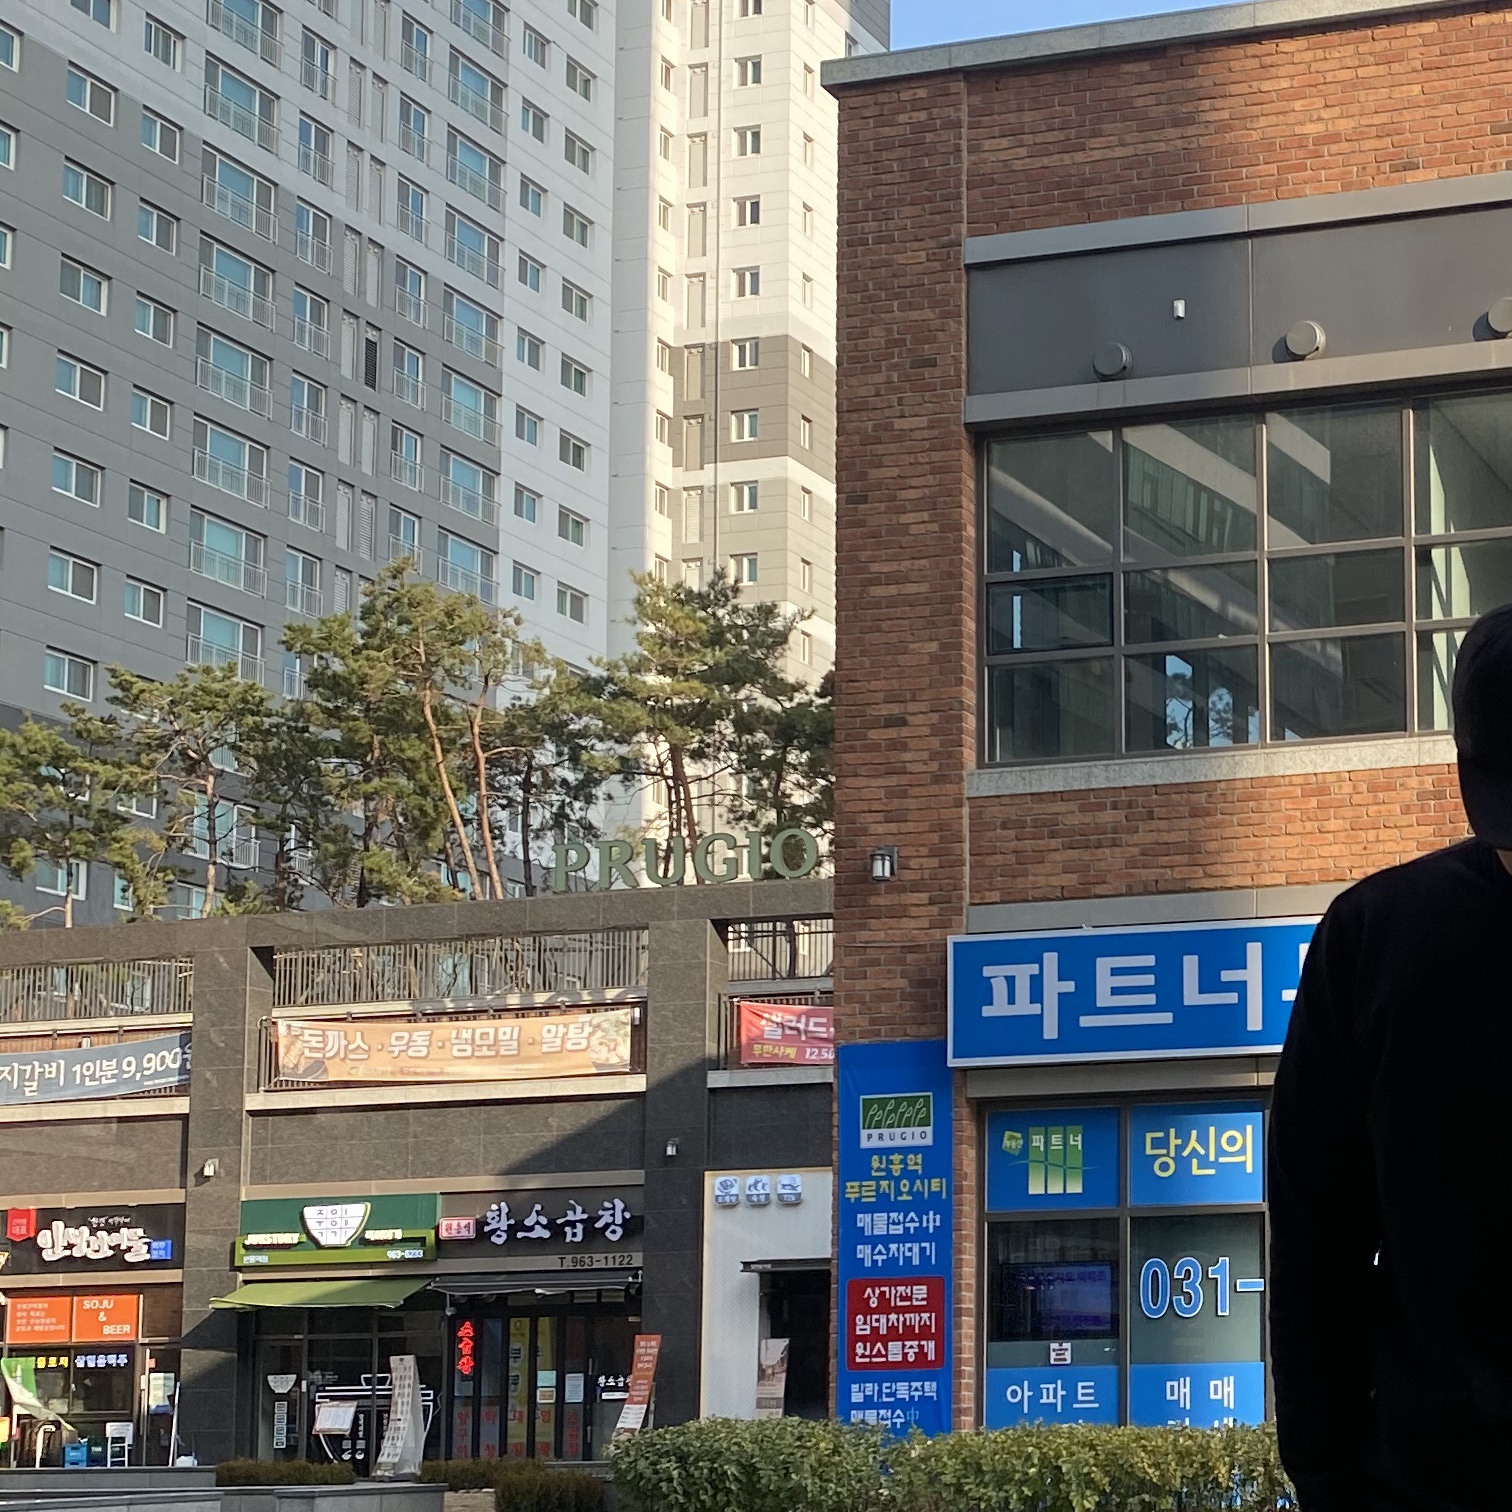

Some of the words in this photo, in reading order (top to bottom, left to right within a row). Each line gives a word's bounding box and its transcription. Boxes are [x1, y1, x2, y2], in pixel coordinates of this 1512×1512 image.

[551, 828, 819, 893] PRUGIO
[981, 940, 1312, 1041] 파트너
[301, 1029, 370, 1060] 돈까스
[387, 1029, 433, 1058] 우동
[450, 1024, 521, 1057] 냉모밀
[72, 1058, 119, 1086] 1인분
[866, 1130, 928, 1142] PRUGIO
[1031, 1132, 1083, 1152] 파트너
[1145, 1124, 1253, 1178] 당신의
[871, 1153, 923, 1177] 원흥역
[845, 1177, 947, 1204] 푸르지오시티
[483, 1198, 632, 1245] 황소곱창
[558, 1254, 634, 1268] T.963-1122
[857, 1242, 936, 1267] 매수자대기
[863, 1285, 928, 1308] 상가전문
[1140, 1257, 1265, 1319] 031-
[82, 1299, 115, 1310] SOJU
[98, 1311, 107, 1322] &
[103, 1324, 131, 1335] BEER
[855, 1312, 936, 1335] 임대차까지
[1006, 1379, 1100, 1414] 아파트
